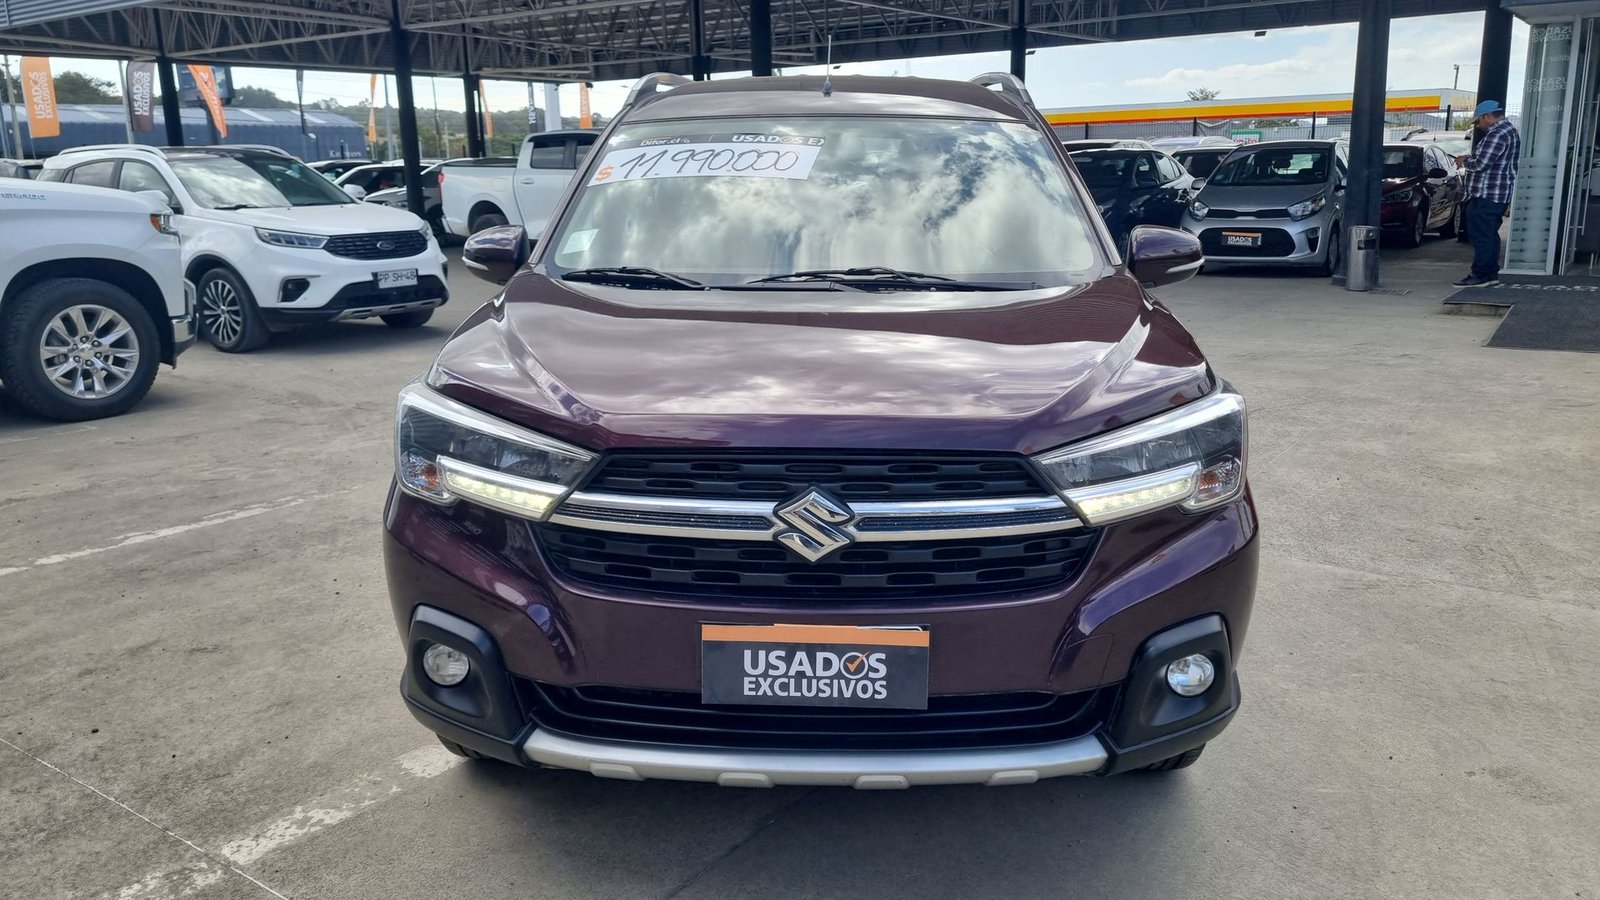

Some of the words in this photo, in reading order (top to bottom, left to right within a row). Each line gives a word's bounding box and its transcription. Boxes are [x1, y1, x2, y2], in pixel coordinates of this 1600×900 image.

[30, 71, 45, 119] USADOS
[133, 71, 143, 116] USADOS
[732, 134, 804, 144] USADOS
[743, 649, 888, 680] USADOS
[743, 677, 888, 700] EXCLUSIVOS
